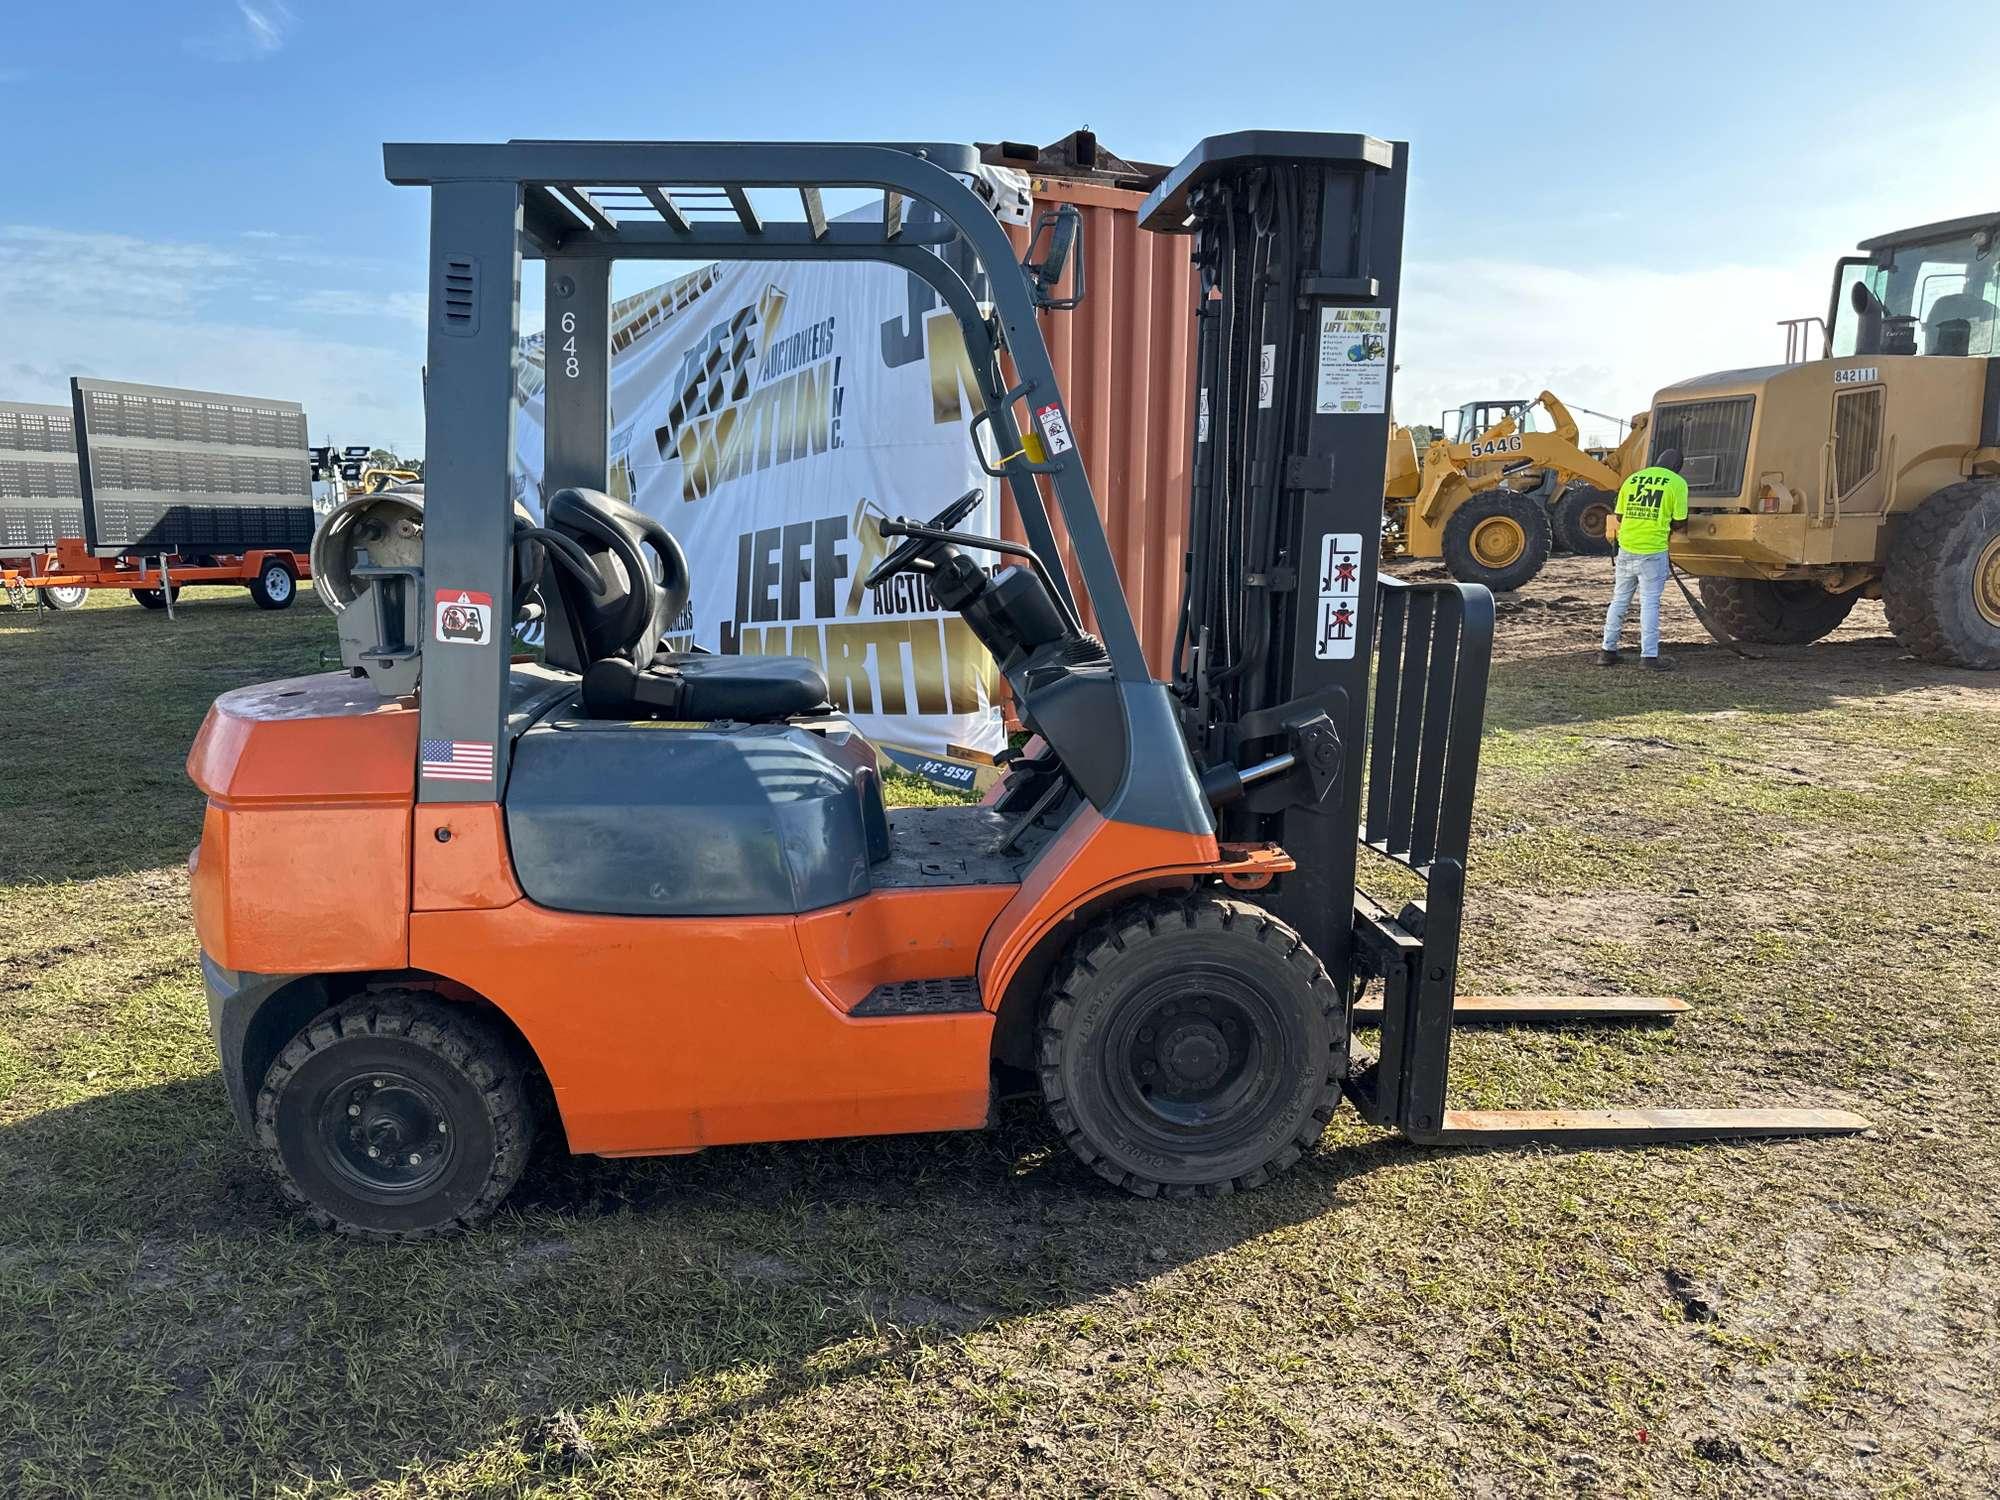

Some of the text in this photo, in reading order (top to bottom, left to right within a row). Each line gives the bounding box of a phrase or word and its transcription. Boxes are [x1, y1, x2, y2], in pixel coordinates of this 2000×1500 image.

[1335, 310, 1349, 321] ALL
[1323, 322, 1342, 333] LIFT
[763, 315, 835, 382] AUCTIONEERS
[1835, 367, 1876, 383] 842111
[1471, 436, 1521, 457] 544G
[1630, 475, 1670, 486] STAFF
[720, 514, 849, 656] JEFF
